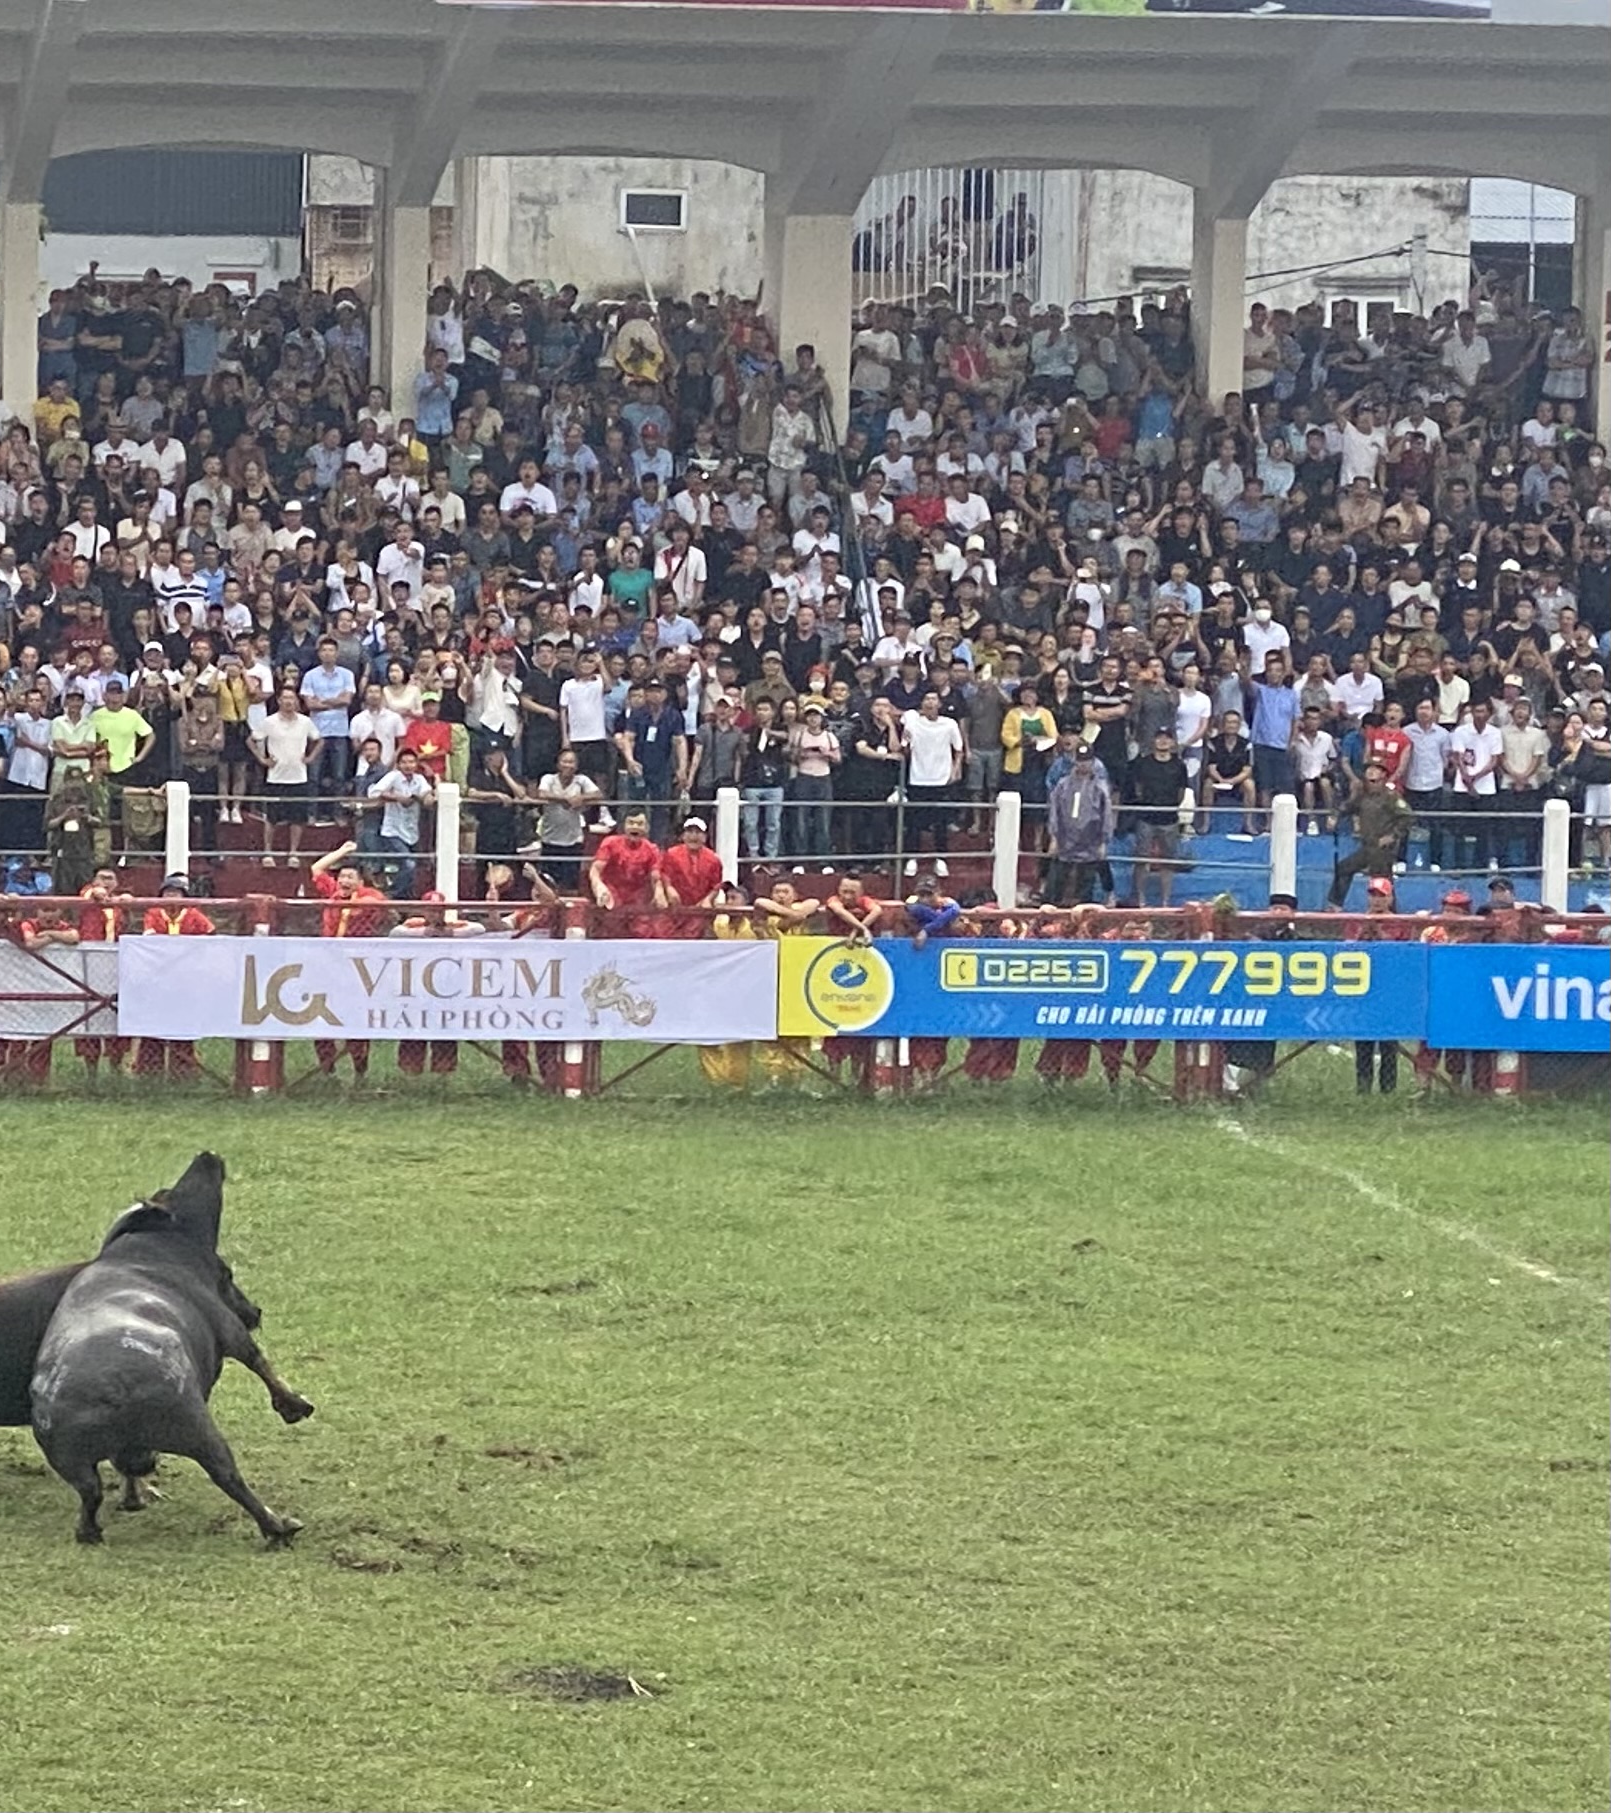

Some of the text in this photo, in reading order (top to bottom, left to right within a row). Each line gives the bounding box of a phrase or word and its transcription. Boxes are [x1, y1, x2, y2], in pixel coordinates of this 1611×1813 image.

[347, 956, 566, 999] VICEM
[983, 949, 1372, 996] 0225.3 777999
[367, 1003, 565, 1030] HẢI PHÒNG
[1036, 1003, 1268, 1027] CHO HẢI PHÒNG THÊM XANH
